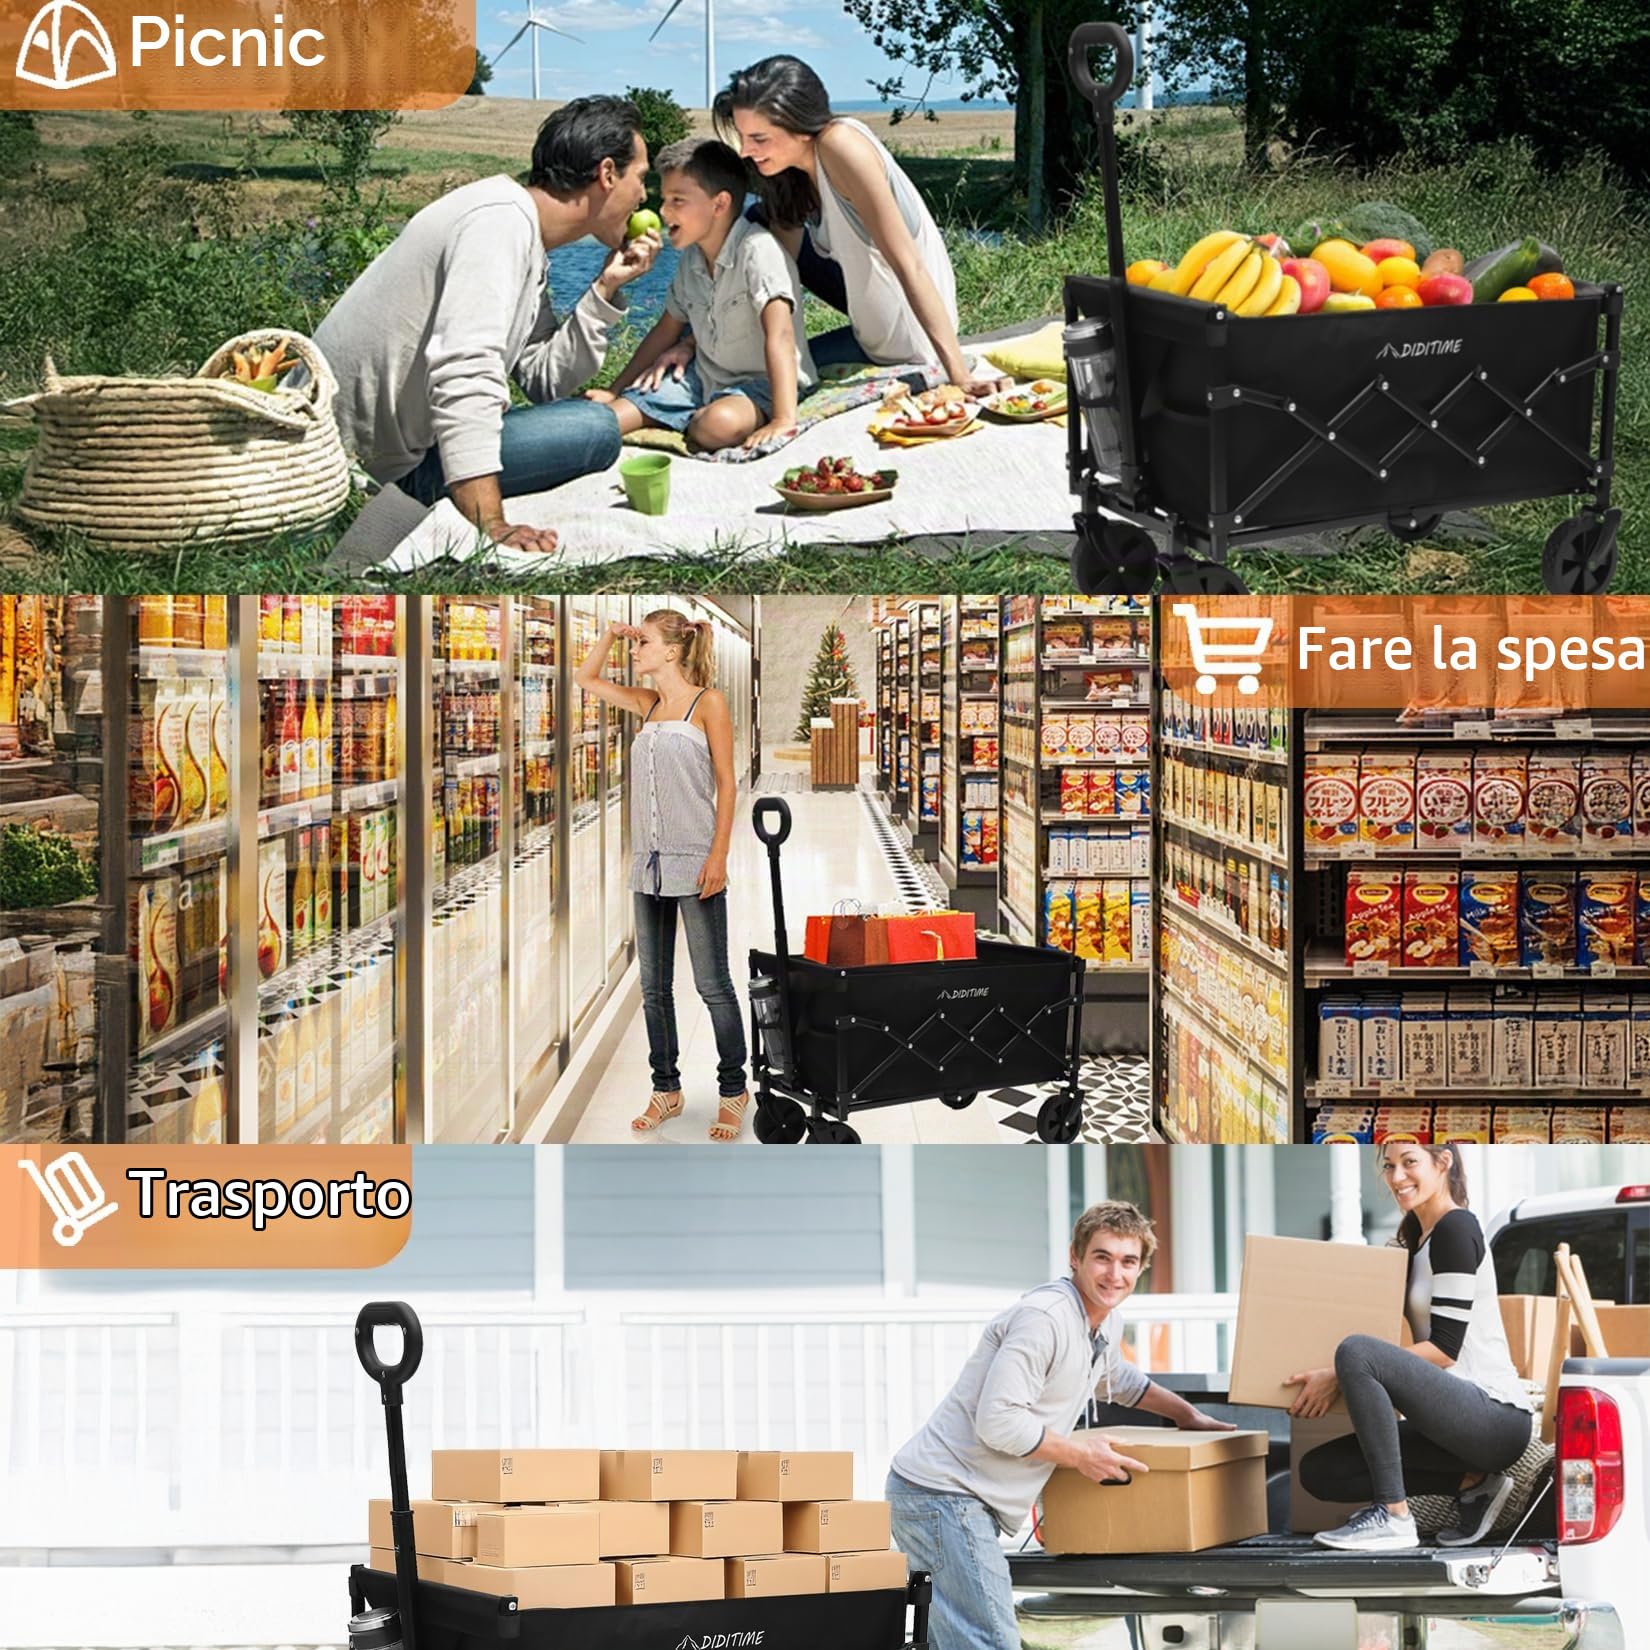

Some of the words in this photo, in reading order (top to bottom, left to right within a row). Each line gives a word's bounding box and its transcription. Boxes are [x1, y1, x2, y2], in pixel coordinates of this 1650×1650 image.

[1400, 338, 1463, 358] DIDITIME
[1309, 796, 1352, 807] フルーツ
[1366, 796, 1409, 807] フルーツ
[1351, 908, 1379, 920] Apple
[1378, 903, 1395, 912] Tea
[1408, 908, 1436, 920] Apple
[1436, 903, 1452, 912] Tea
[951, 987, 989, 999] DIDITIME
[701, 1630, 765, 1650] DIDITIME
